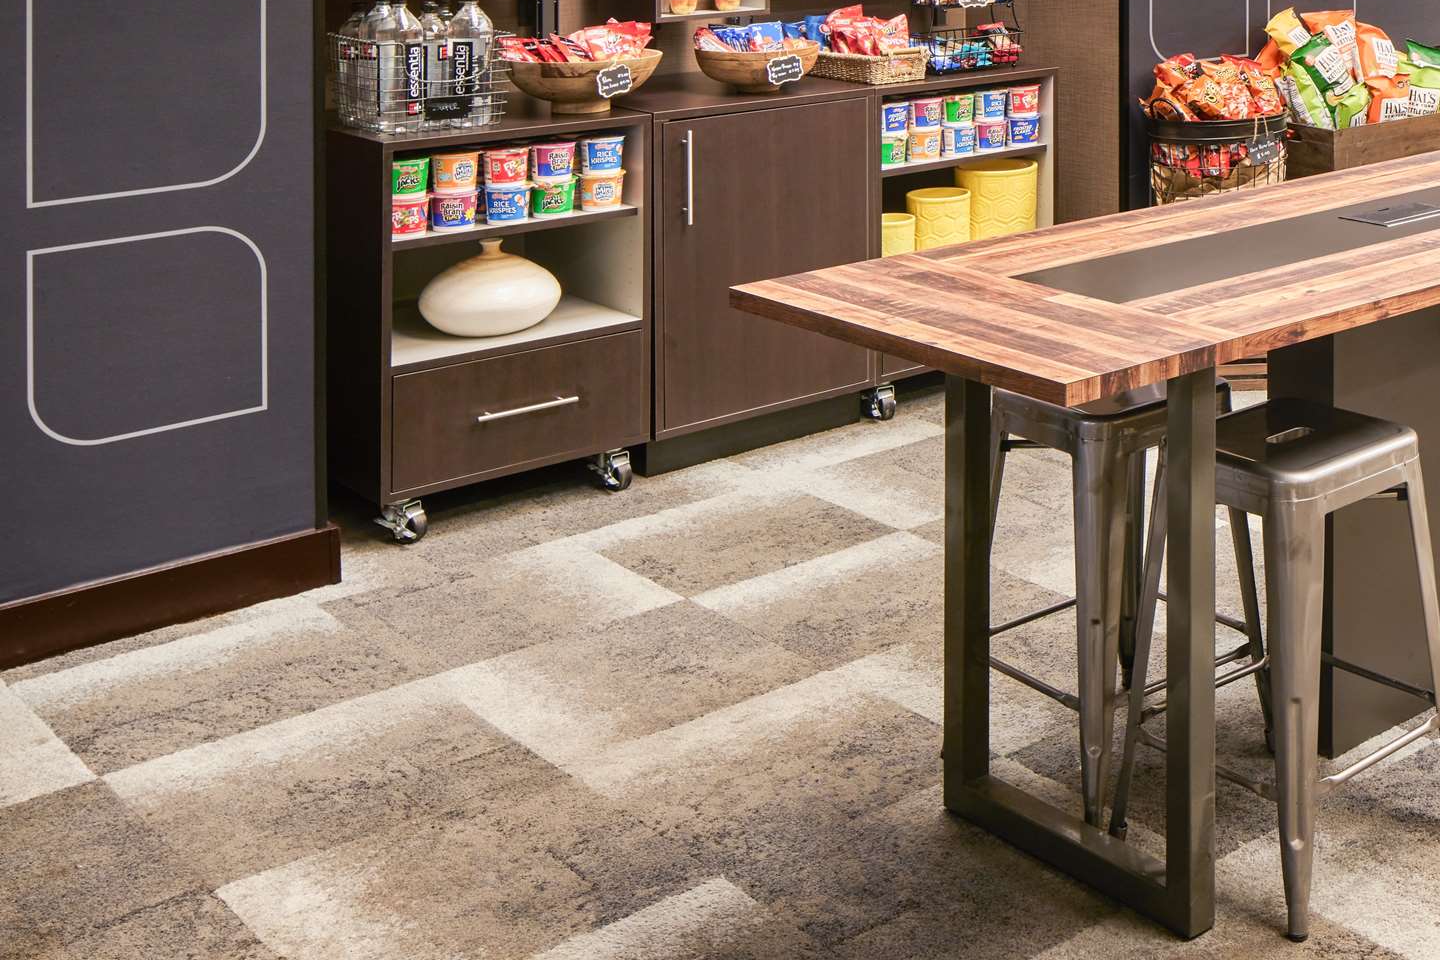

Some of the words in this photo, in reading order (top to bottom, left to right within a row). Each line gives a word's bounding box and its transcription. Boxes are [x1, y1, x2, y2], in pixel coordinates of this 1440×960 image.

[409, 46, 420, 98] essentia
[455, 44, 466, 95] essentia
[1409, 89, 1437, 105] HAL'S
[489, 206, 518, 215] KRISPIES
